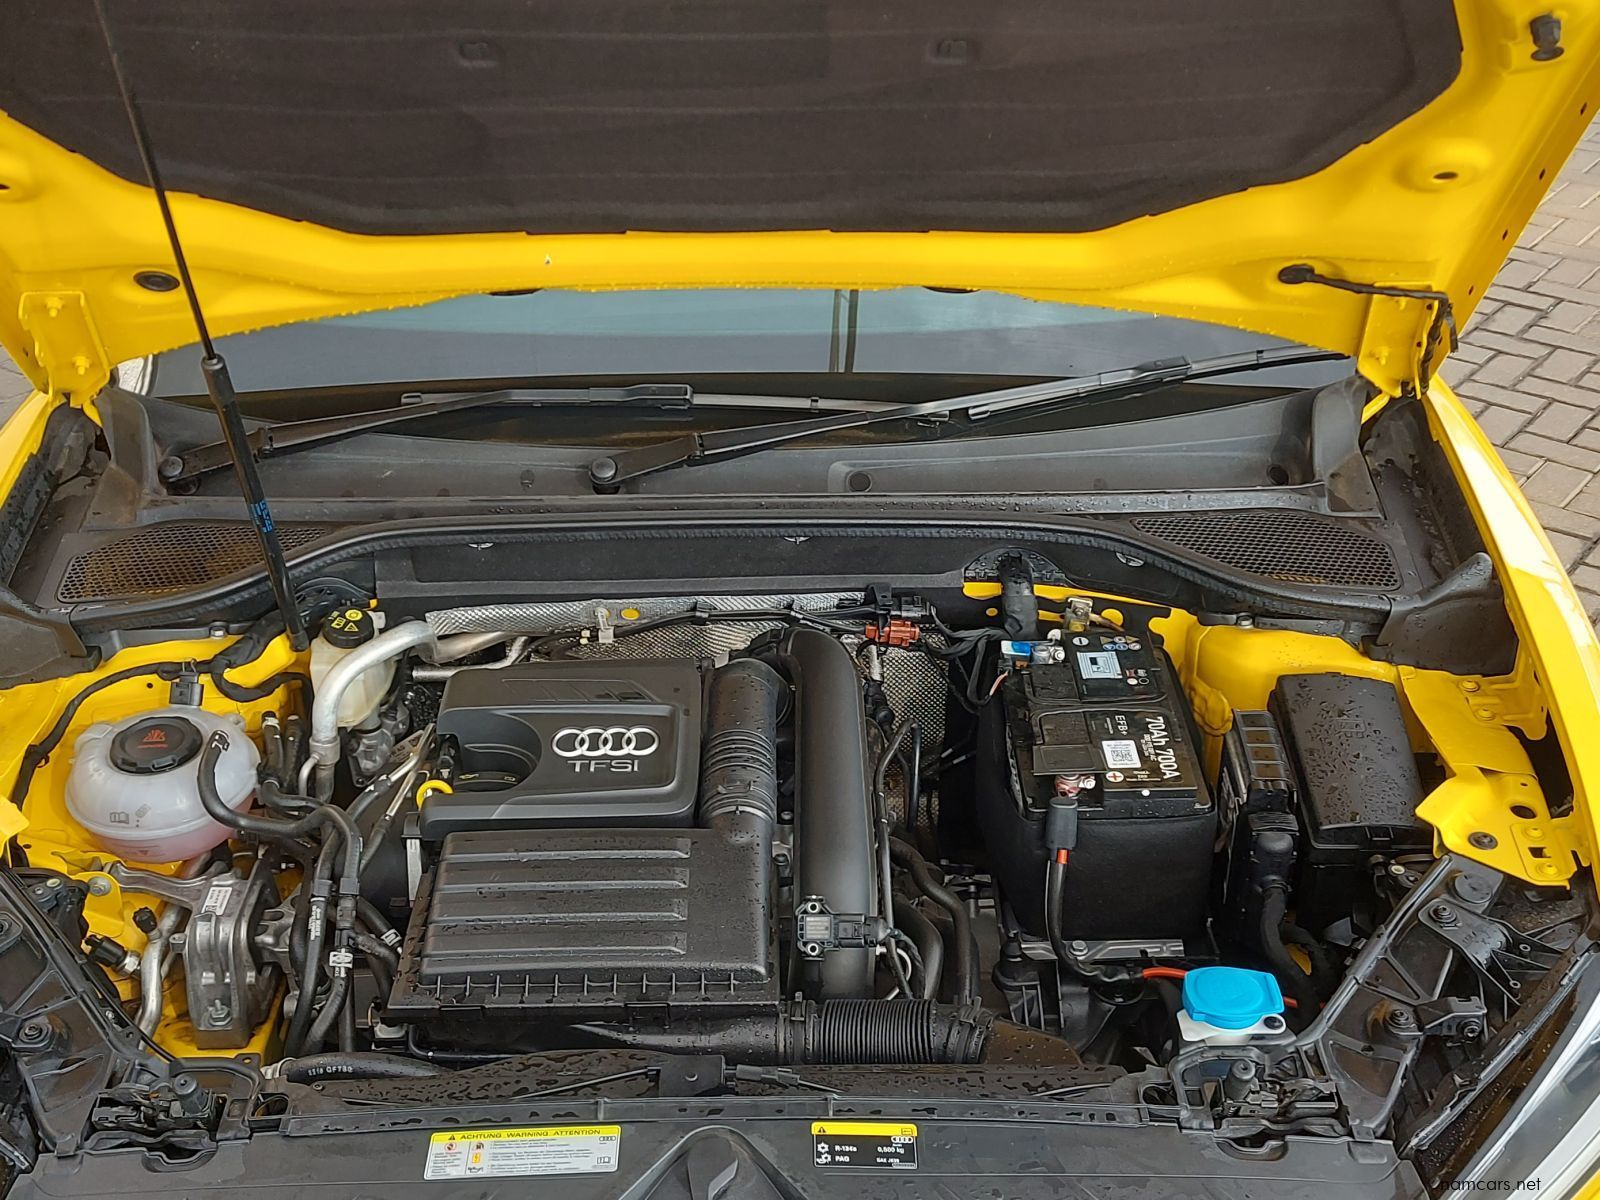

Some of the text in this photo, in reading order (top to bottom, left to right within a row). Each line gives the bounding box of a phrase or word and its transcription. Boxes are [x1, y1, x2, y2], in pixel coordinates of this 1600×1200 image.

[1115, 715, 1128, 735] EFB+
[1145, 716, 1181, 779] 70Ah 700A
[567, 759, 639, 772] TFSI
[460, 1133, 502, 1141] ACHTUNG
[553, 1129, 601, 1137] ATTENTION
[896, 1146, 905, 1154] kg
